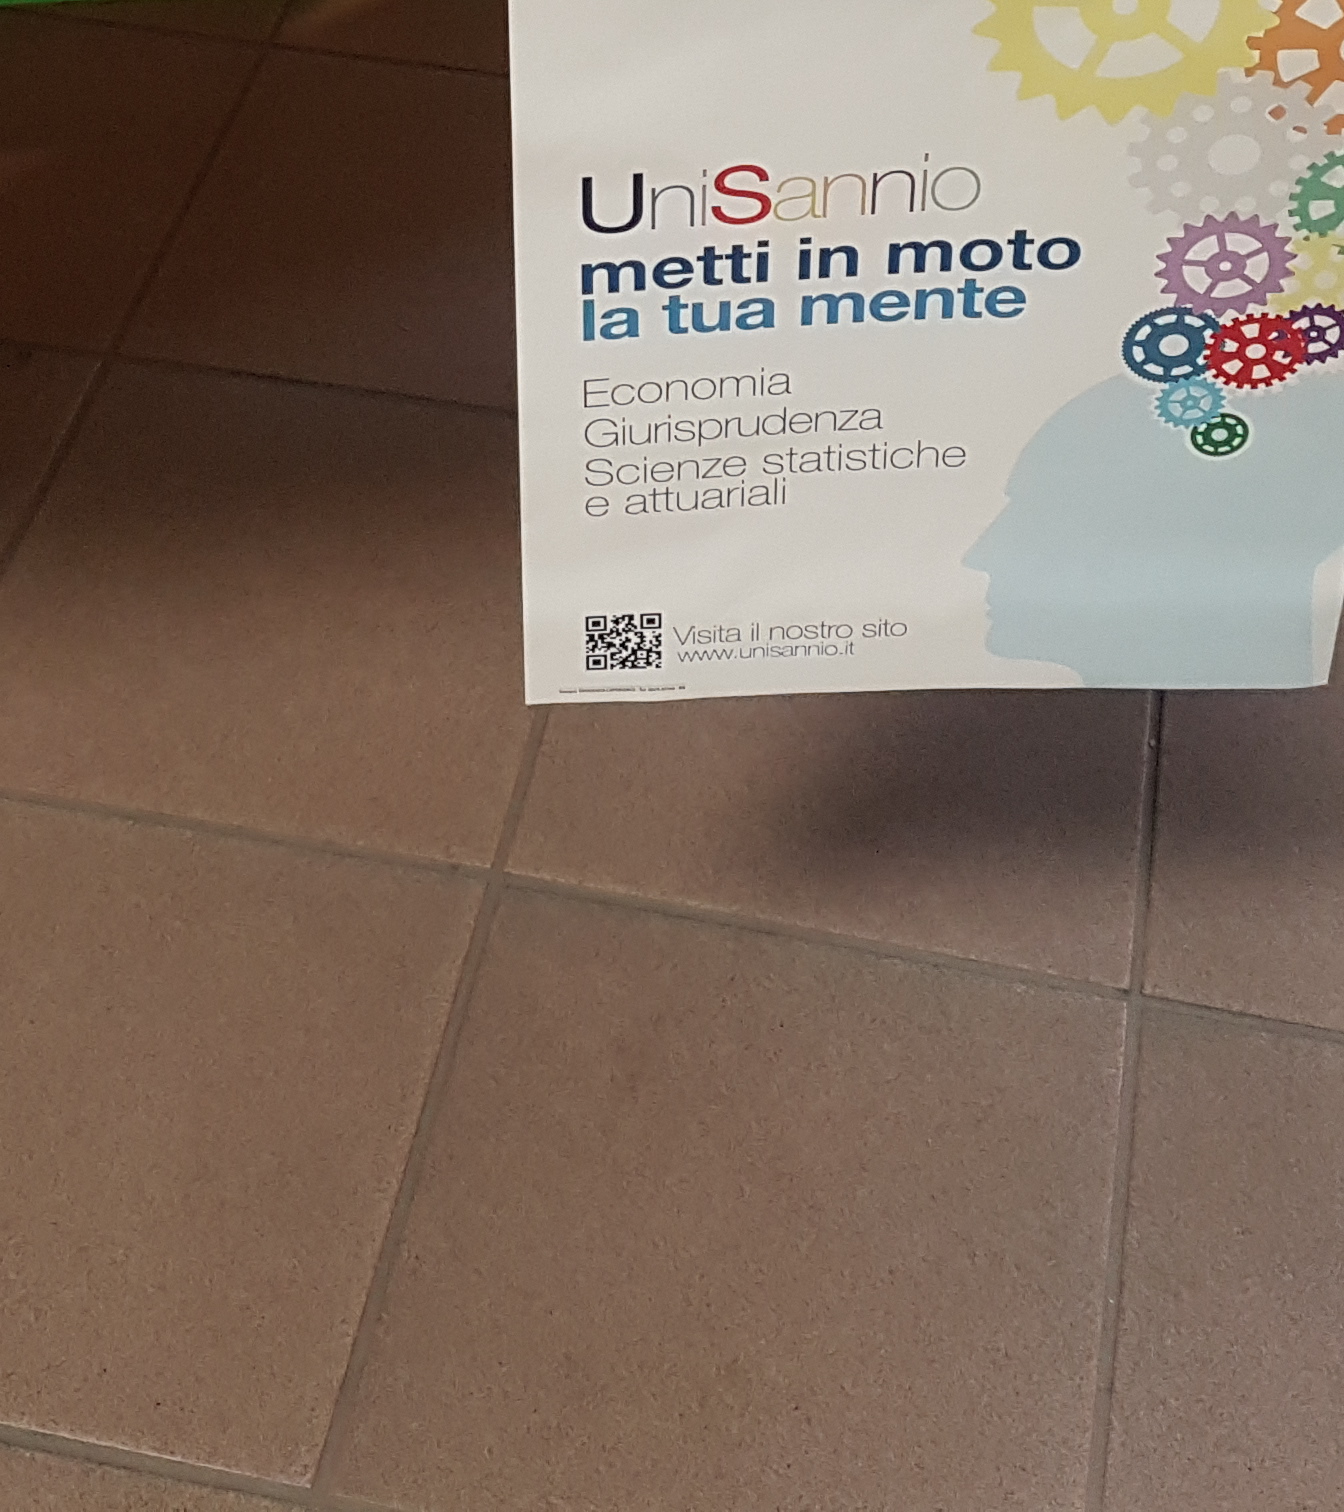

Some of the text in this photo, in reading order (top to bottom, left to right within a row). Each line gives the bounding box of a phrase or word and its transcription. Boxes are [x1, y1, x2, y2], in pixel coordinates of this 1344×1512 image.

[581, 152, 982, 235] UniSannio
[581, 228, 1083, 296] metti in moto
[582, 278, 1028, 343] la tua mente
[583, 367, 793, 409] Economia
[584, 406, 884, 449] Giurisprudenza
[584, 439, 967, 487] Scienze statistiche
[584, 477, 788, 518] e attuariali
[672, 617, 909, 647] Visita il nostro sito
[676, 640, 856, 664] www.unisannio.it
